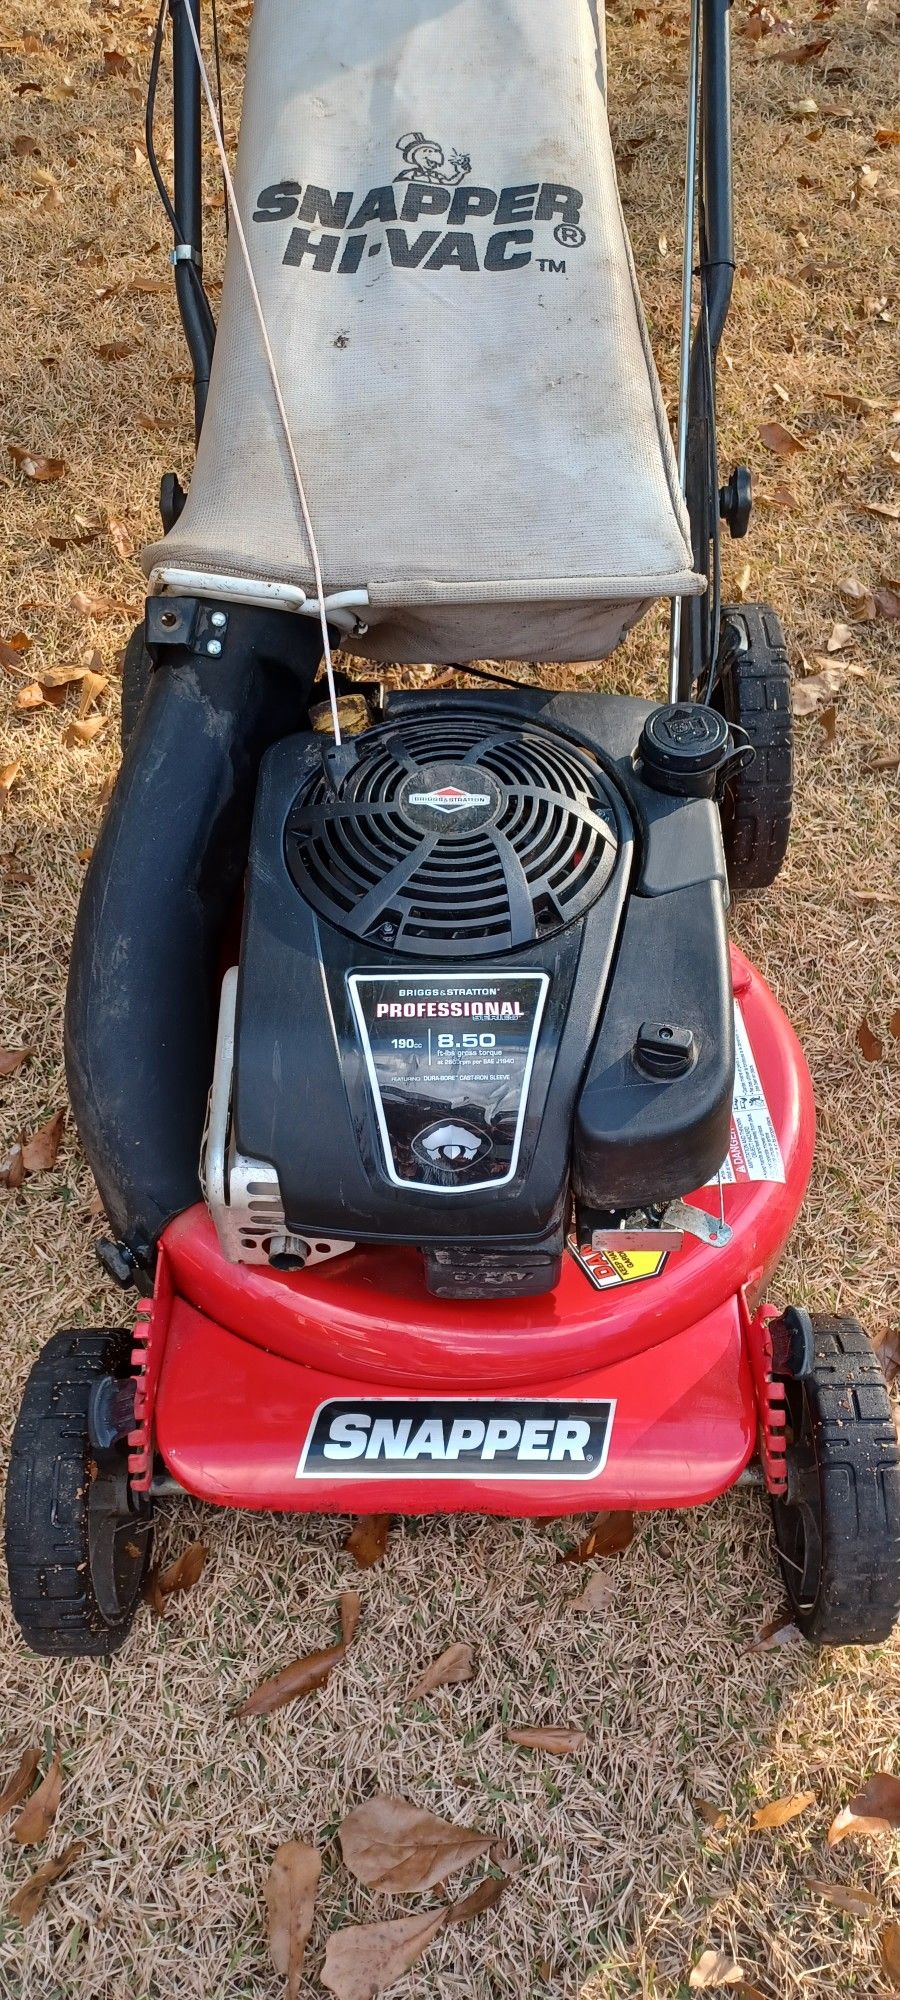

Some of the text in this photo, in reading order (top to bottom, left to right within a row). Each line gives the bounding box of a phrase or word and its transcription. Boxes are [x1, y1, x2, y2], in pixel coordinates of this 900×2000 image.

[253, 181, 584, 229] SNAPPER
[282, 226, 534, 273] HI-VAC
[376, 1001, 524, 1018] PROFESSIONAL
[437, 1033, 496, 1048] 8.50
[457, 1050, 477, 1058] gross
[614, 1261, 629, 1276] KEEP
[323, 1413, 591, 1461] SNAPPER
